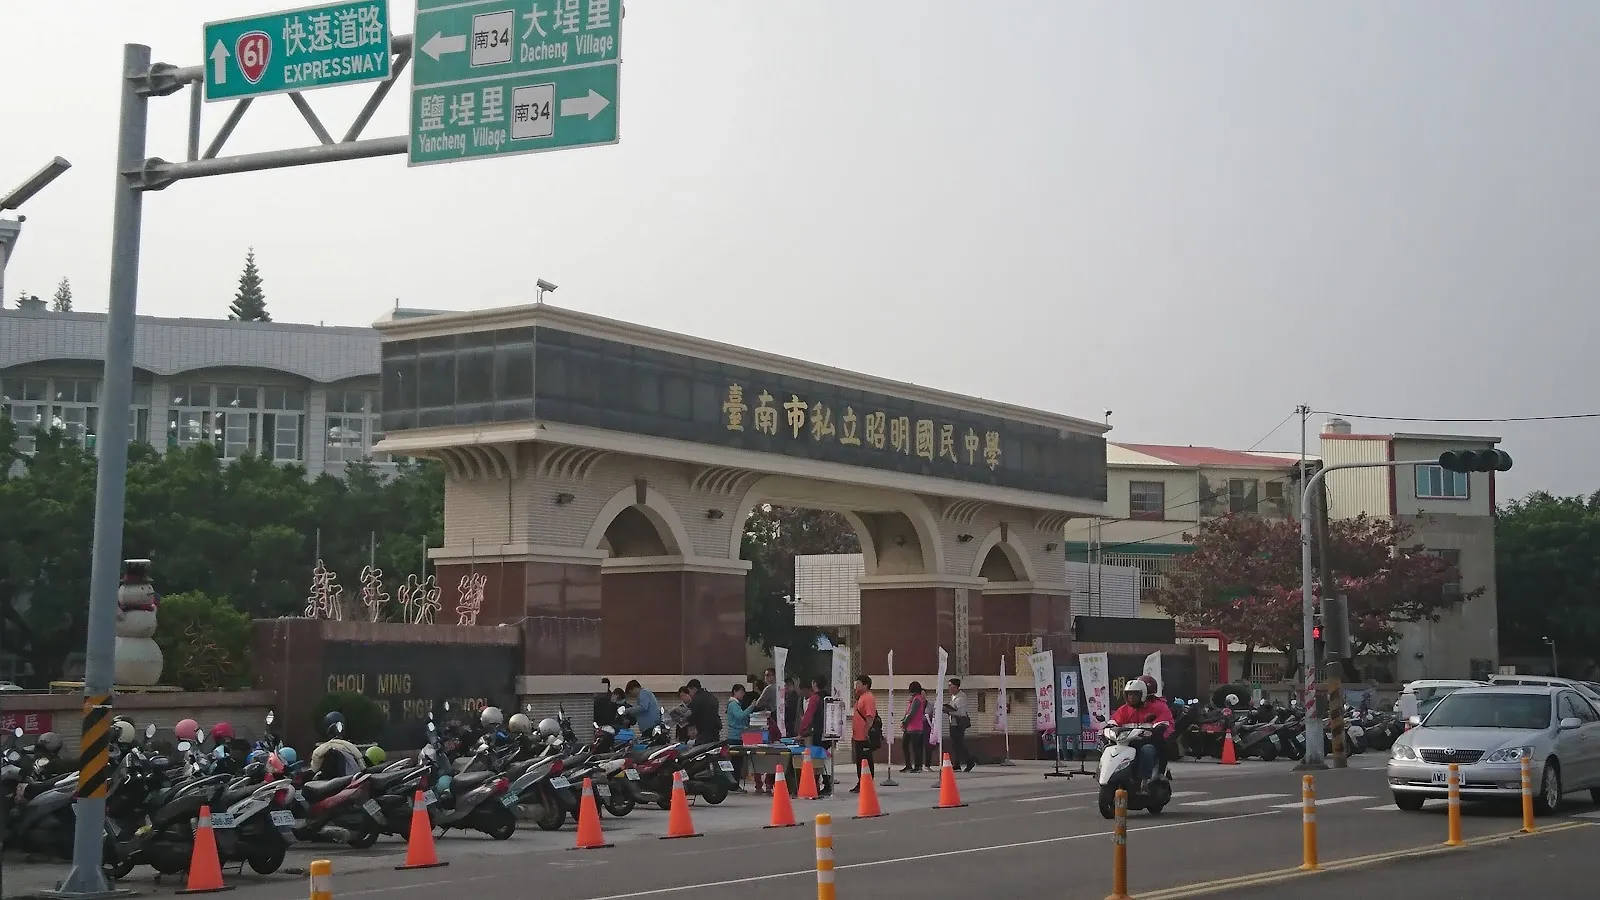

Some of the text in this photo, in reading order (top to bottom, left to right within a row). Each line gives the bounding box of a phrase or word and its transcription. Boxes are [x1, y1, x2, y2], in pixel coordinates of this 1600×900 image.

[282, 6, 383, 57] 快速道路
[520, 0, 611, 41] 大埕里
[474, 27, 510, 50] 南34
[520, 34, 613, 64] Dacheng Village
[243, 40, 265, 68] 61
[283, 52, 385, 83] EXPRESSWAY
[419, 87, 505, 132] 鹽埕里
[513, 100, 551, 123] 南34
[418, 126, 507, 155] Yancheng Village
[723, 382, 1002, 471] 臺南市私立昭明國民中學
[327, 673, 412, 694] CHOU MING
